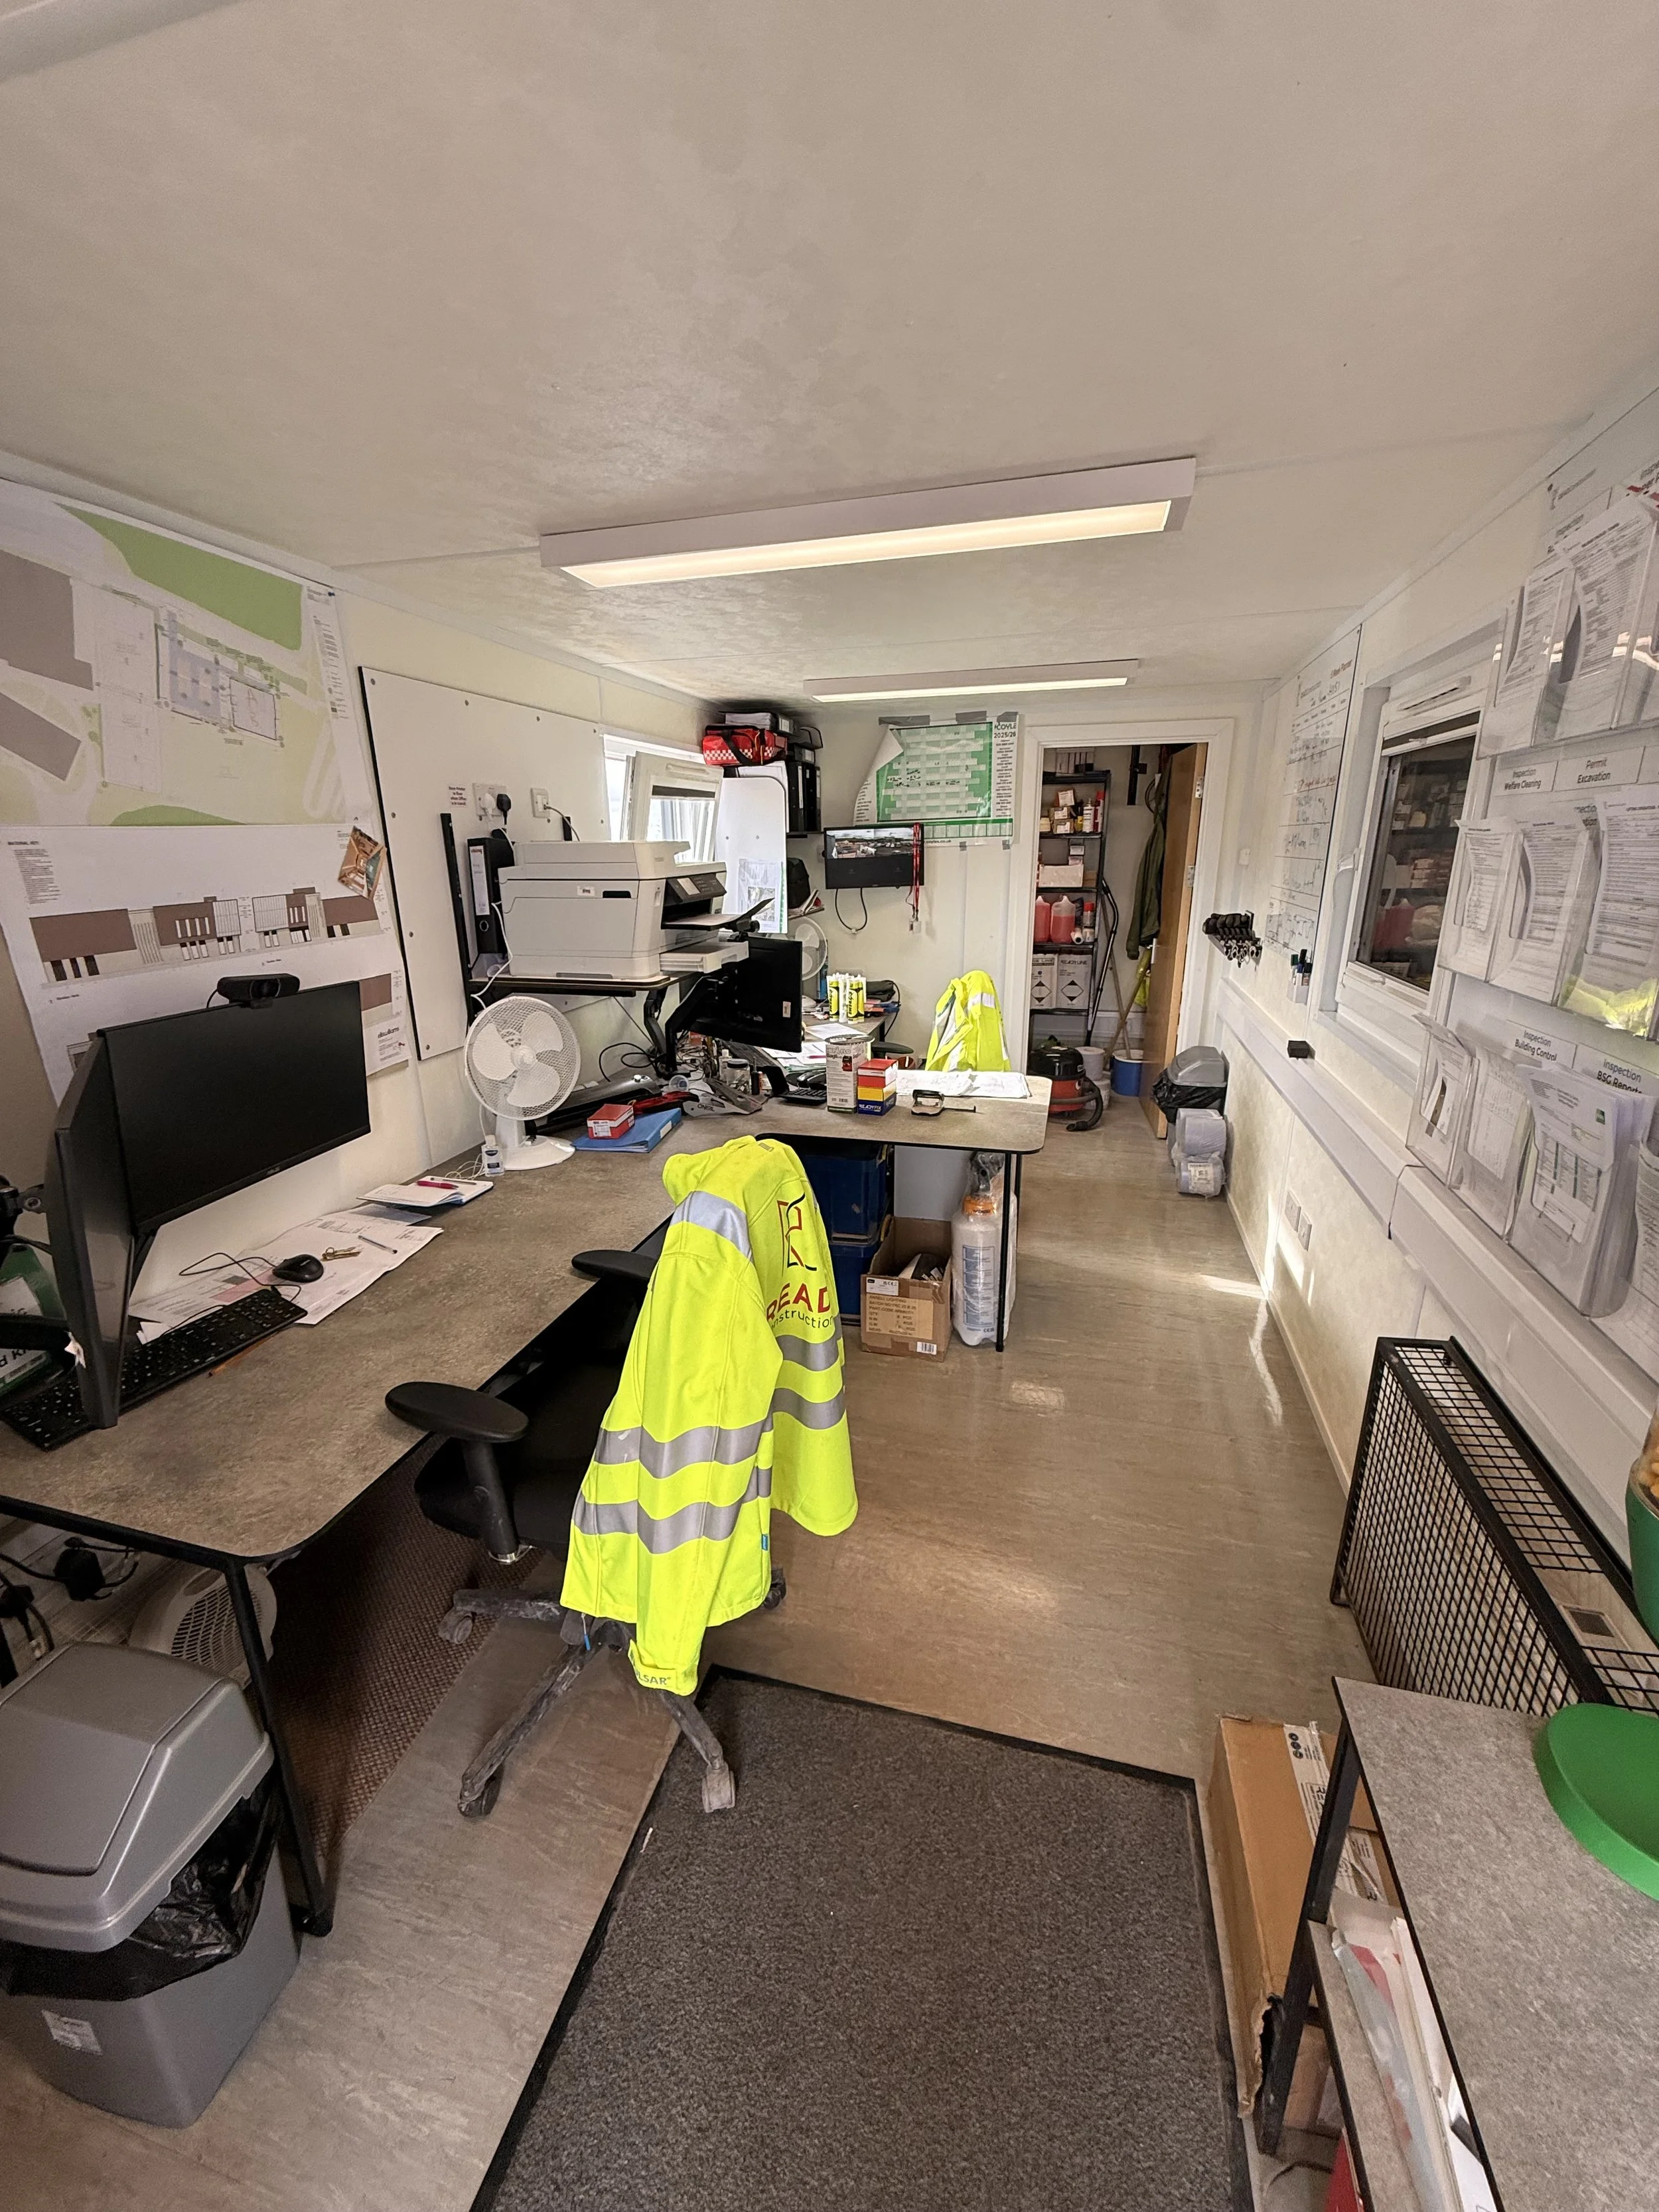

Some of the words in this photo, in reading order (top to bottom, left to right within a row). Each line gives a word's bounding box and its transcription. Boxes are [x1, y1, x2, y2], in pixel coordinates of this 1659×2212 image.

[1585, 759, 1607, 769] Permit
[1577, 771, 1611, 784] Excavation
[1524, 1029, 1551, 1048] Inspection
[1515, 1039, 1535, 1056] Building
[1536, 1047, 1557, 1061] Control
[1603, 1059, 1642, 1083] Inspection
[766, 1282, 831, 1321] READ
